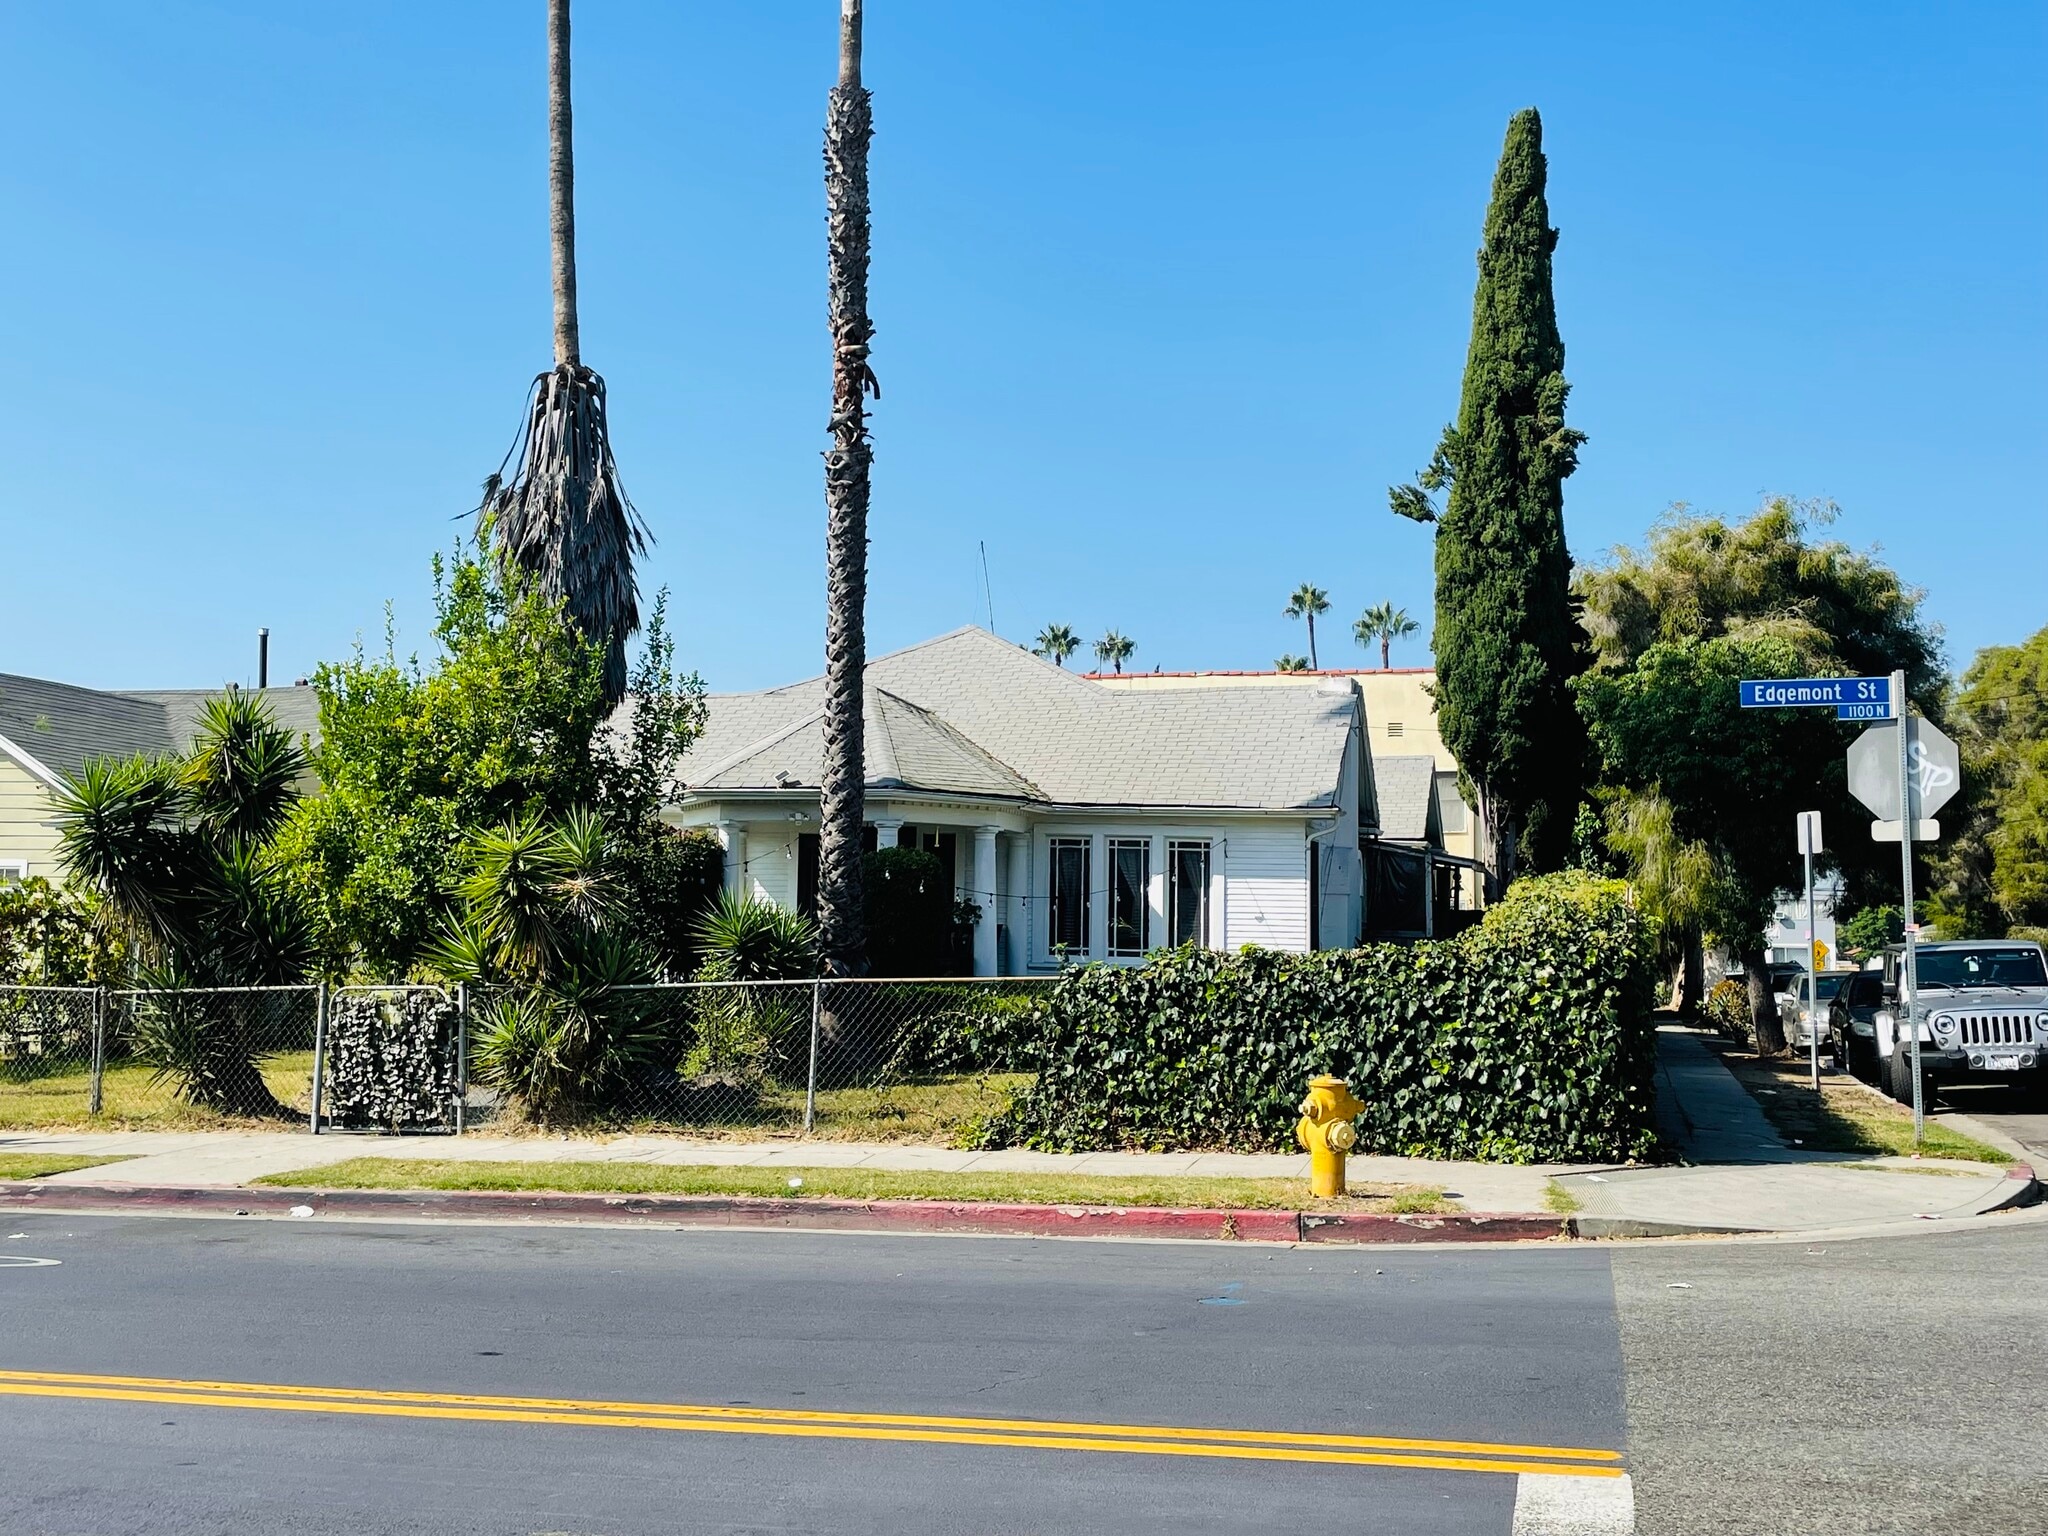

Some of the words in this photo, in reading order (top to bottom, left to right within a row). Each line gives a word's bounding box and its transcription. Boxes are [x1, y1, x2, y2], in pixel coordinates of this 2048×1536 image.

[1754, 683, 1842, 704] Edgemont
[1857, 682, 1877, 699] St
[1849, 705, 1873, 717] 1100
[1876, 705, 1884, 716] N
